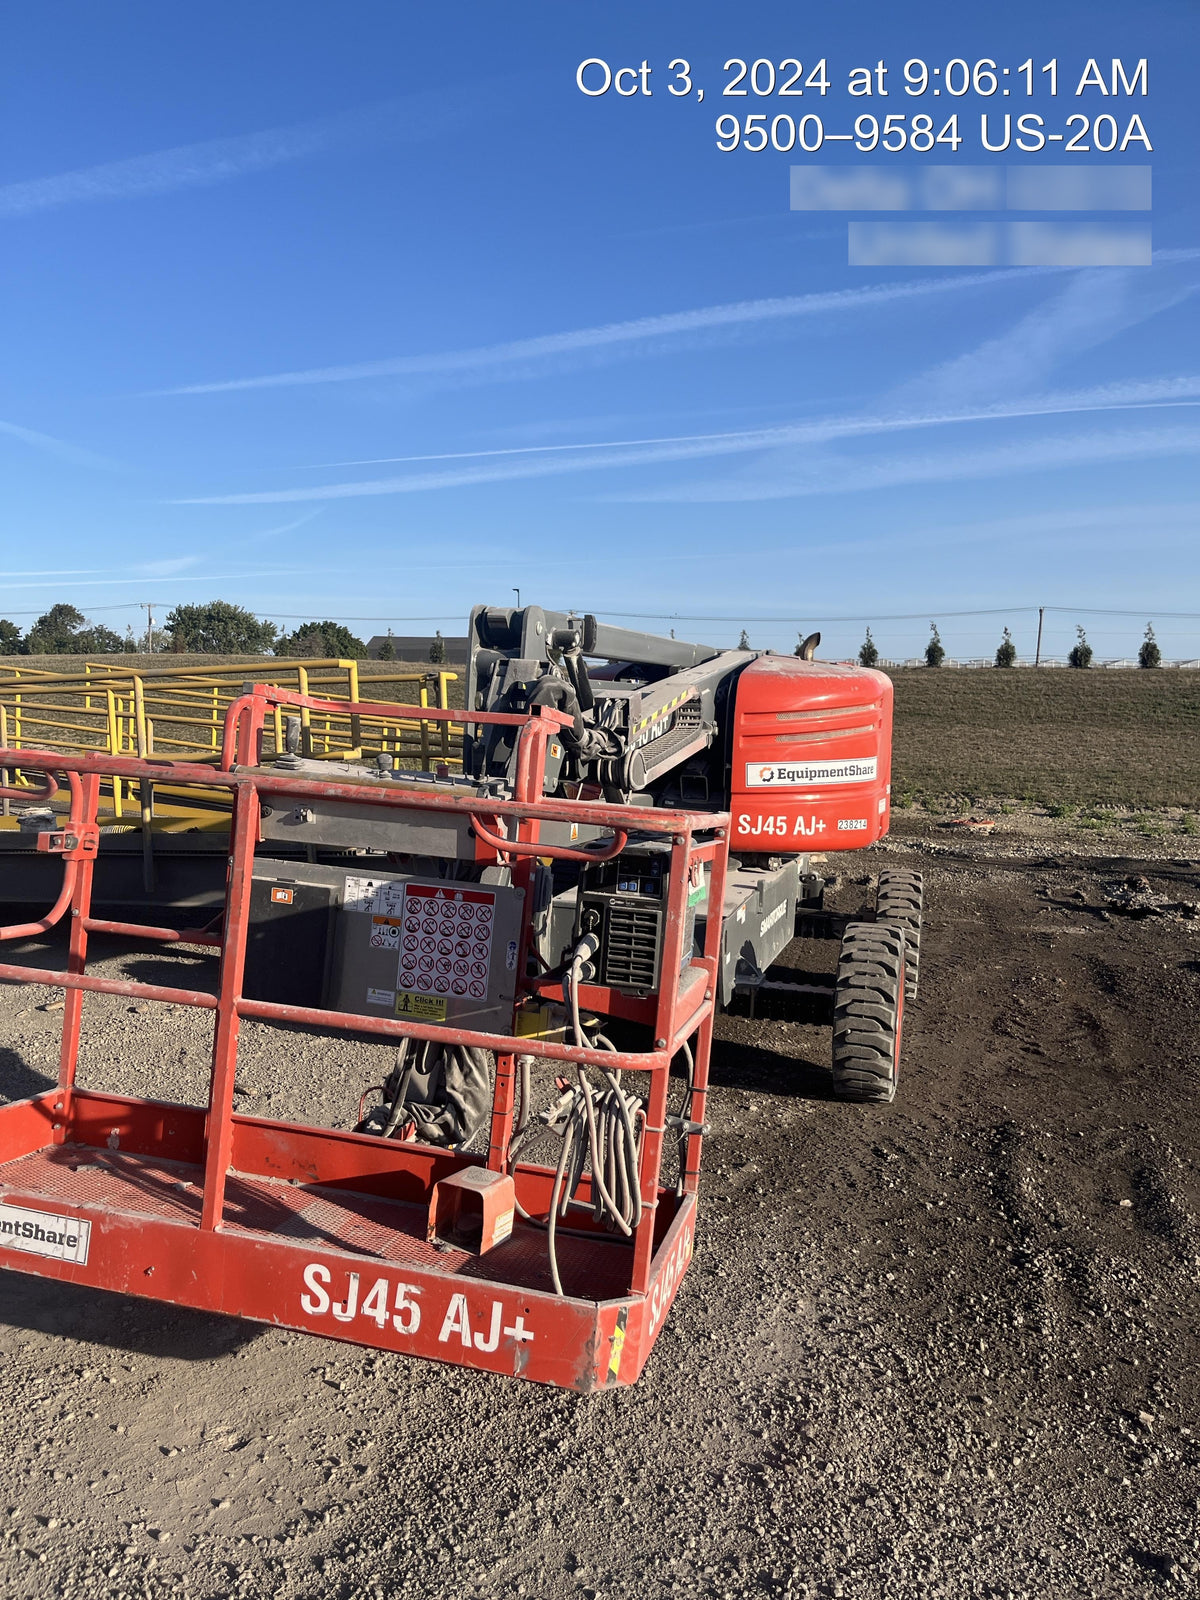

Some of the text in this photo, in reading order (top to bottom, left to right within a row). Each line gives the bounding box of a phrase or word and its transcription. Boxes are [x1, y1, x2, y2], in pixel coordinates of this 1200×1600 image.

[777, 764, 874, 782] EquipmentShare
[737, 814, 827, 836] SJ45 AJ+
[414, 995, 433, 1004] Click
[0, 1219, 78, 1248] ntShare
[300, 1263, 534, 1352] SJ45 AJ+
